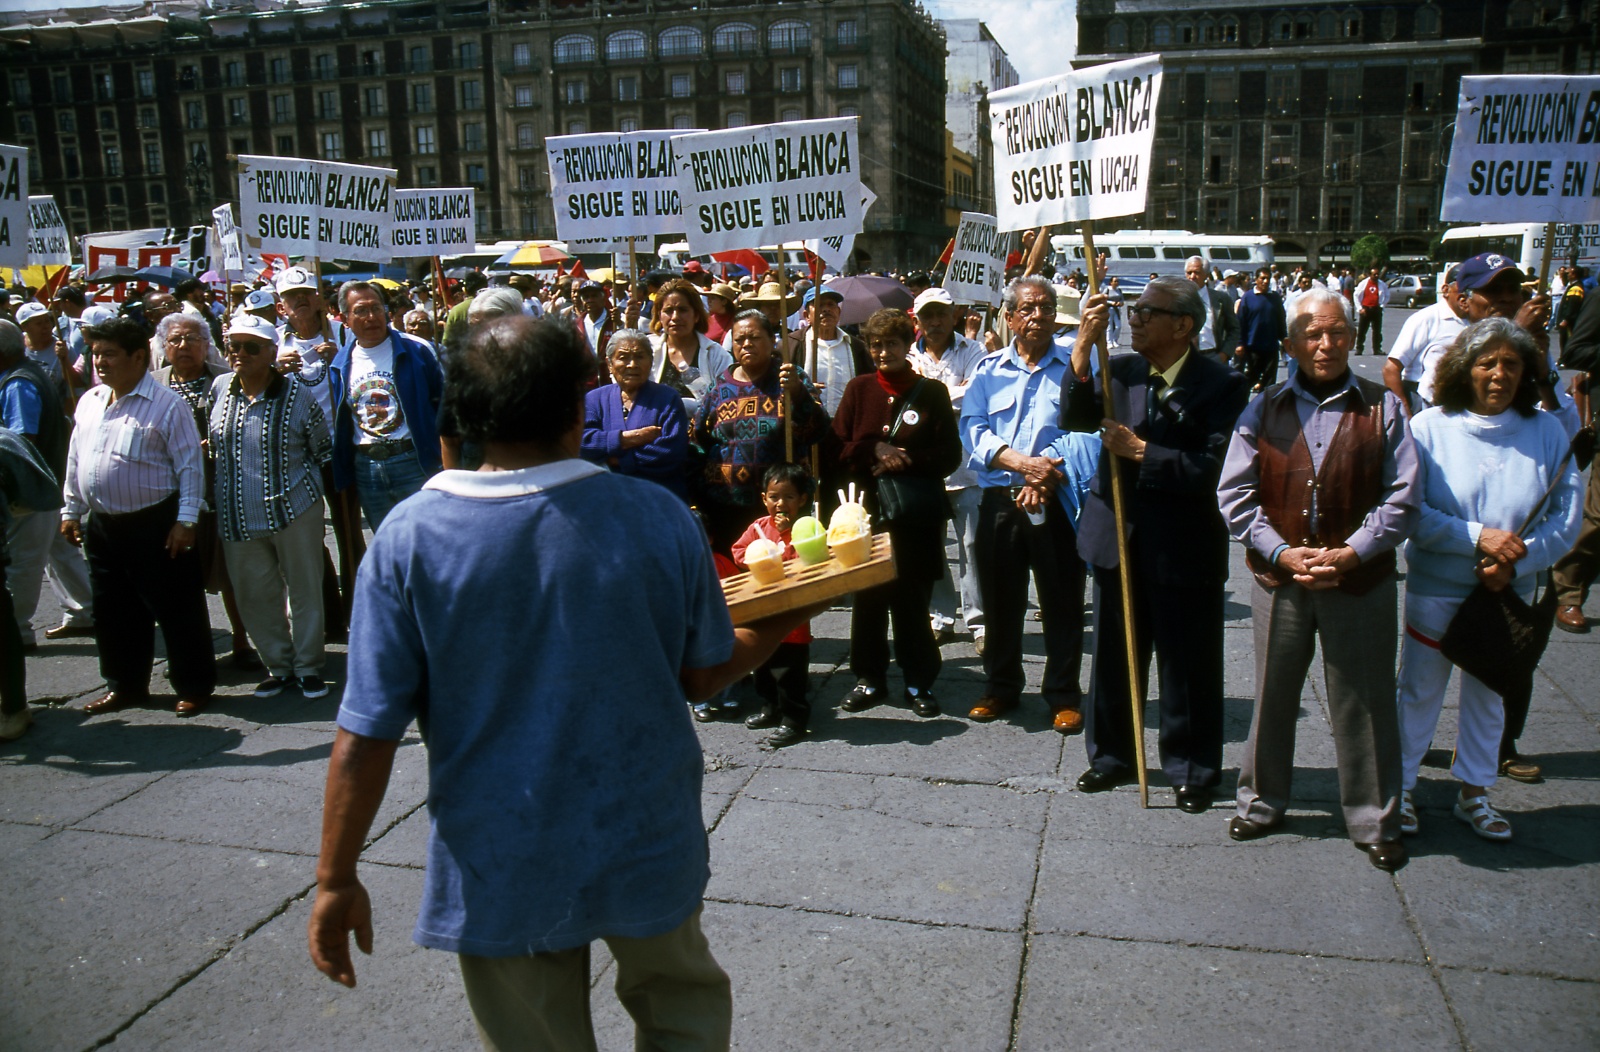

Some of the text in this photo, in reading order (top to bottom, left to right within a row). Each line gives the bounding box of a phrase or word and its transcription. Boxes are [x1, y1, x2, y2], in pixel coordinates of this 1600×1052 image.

[1005, 74, 1153, 156] REVOLUCIÓN BLANCA
[1476, 82, 1581, 144] REVOLUCIÓN
[563, 136, 634, 184] REVOLUCIÓN
[690, 131, 851, 193] REVOLUCIÓN BLANCA
[1011, 154, 1139, 206] SIGUE EN LUCHA
[1468, 160, 1552, 196] SIGUE
[1561, 161, 1588, 197] EN
[256, 165, 390, 213] REVOLUCIÓN BLANCA
[429, 194, 471, 221] BLANCA
[568, 191, 624, 220] SIGUE
[632, 190, 648, 216] EN
[258, 213, 310, 240] SIGUE
[318, 217, 333, 243] EN
[339, 221, 380, 249] LUCHA
[699, 190, 846, 234] SIGUE EN LUCHA
[426, 228, 438, 245] EN
[441, 227, 467, 244] LUCHA
[950, 259, 985, 285] SIGUE
